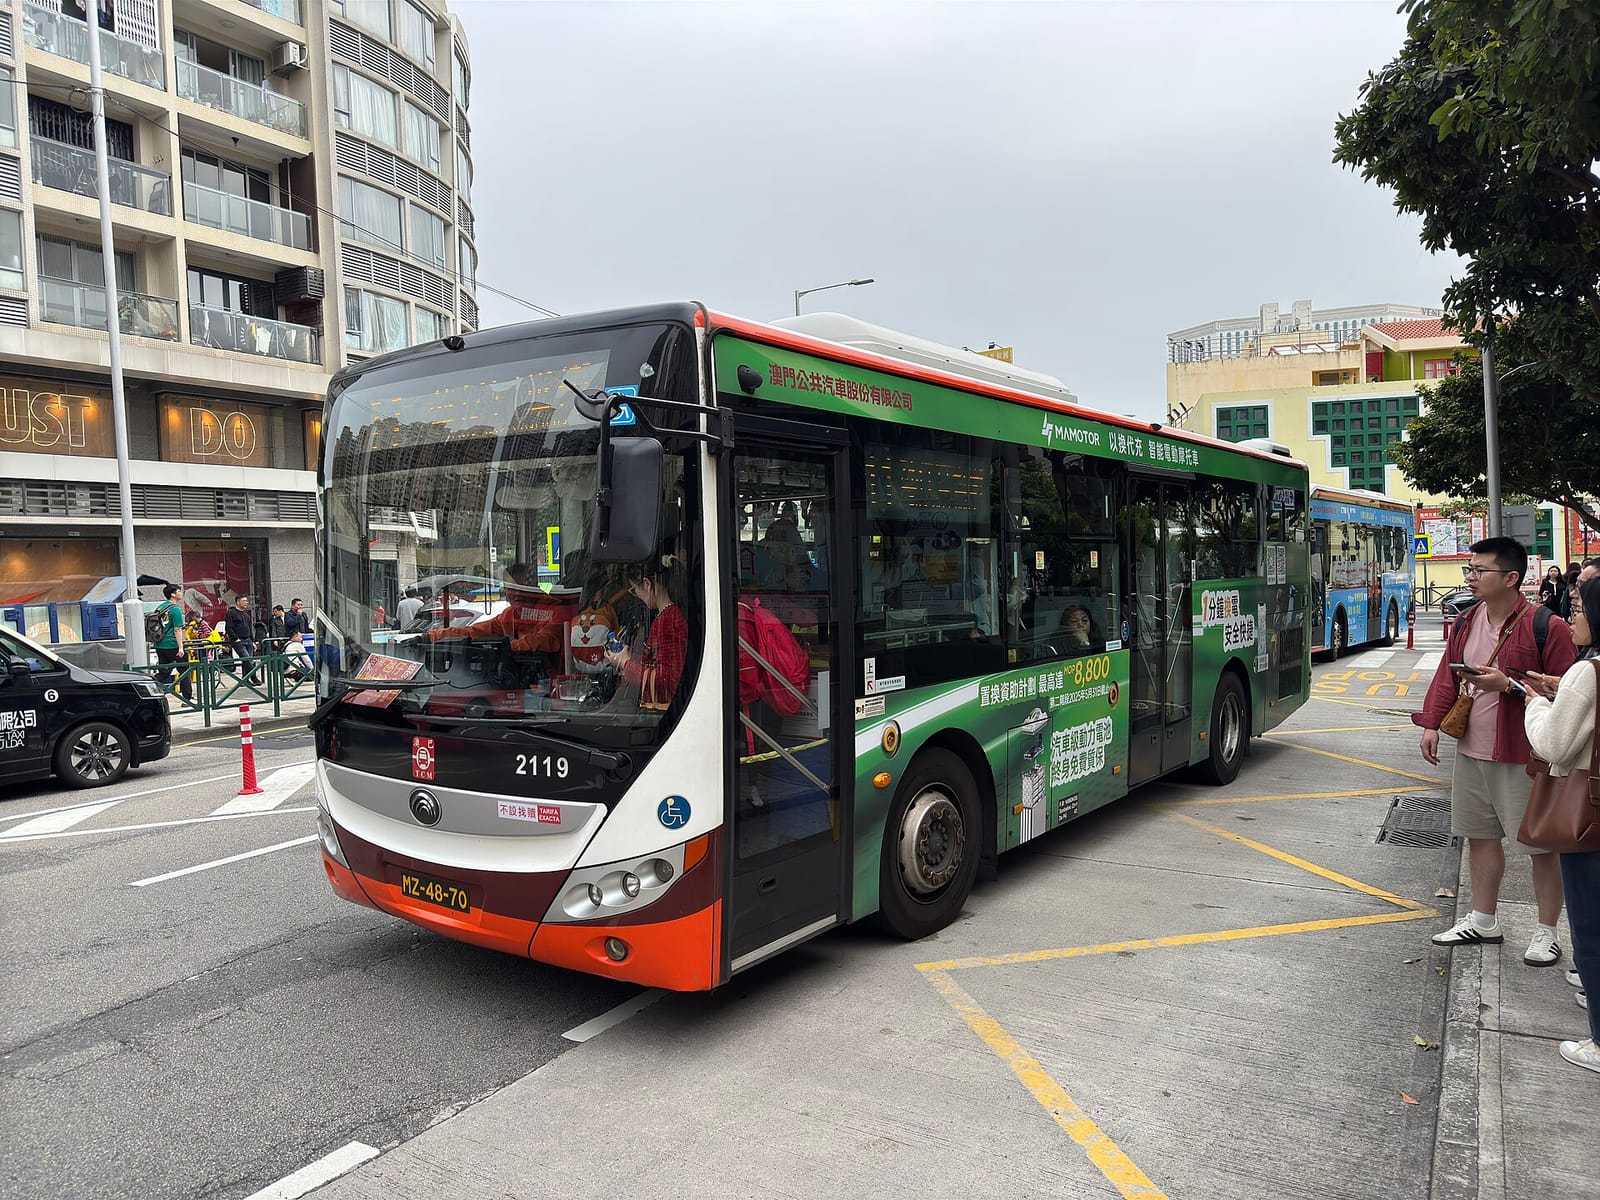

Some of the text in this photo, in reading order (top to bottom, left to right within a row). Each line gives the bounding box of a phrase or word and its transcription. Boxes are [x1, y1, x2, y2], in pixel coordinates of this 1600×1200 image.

[768, 364, 913, 411] 澳門公共汽車股份有限公司
[190, 407, 256, 459] DO
[1054, 424, 1101, 446] MAMOTOR
[1108, 431, 1144, 457] 以換代充
[1225, 620, 1254, 646] 安全快捷
[980, 676, 1036, 706] 置換資助計劃
[1038, 672, 1064, 693] 最高達
[1074, 655, 1110, 688] 8,800
[1311, 681, 1411, 697] US
[1320, 670, 1427, 682] TOP
[1051, 721, 1112, 757] 汽車級動力電池
[515, 754, 569, 778] 2119
[1051, 746, 1104, 781] 終身免費質保
[402, 874, 468, 909] MZ-48-70
